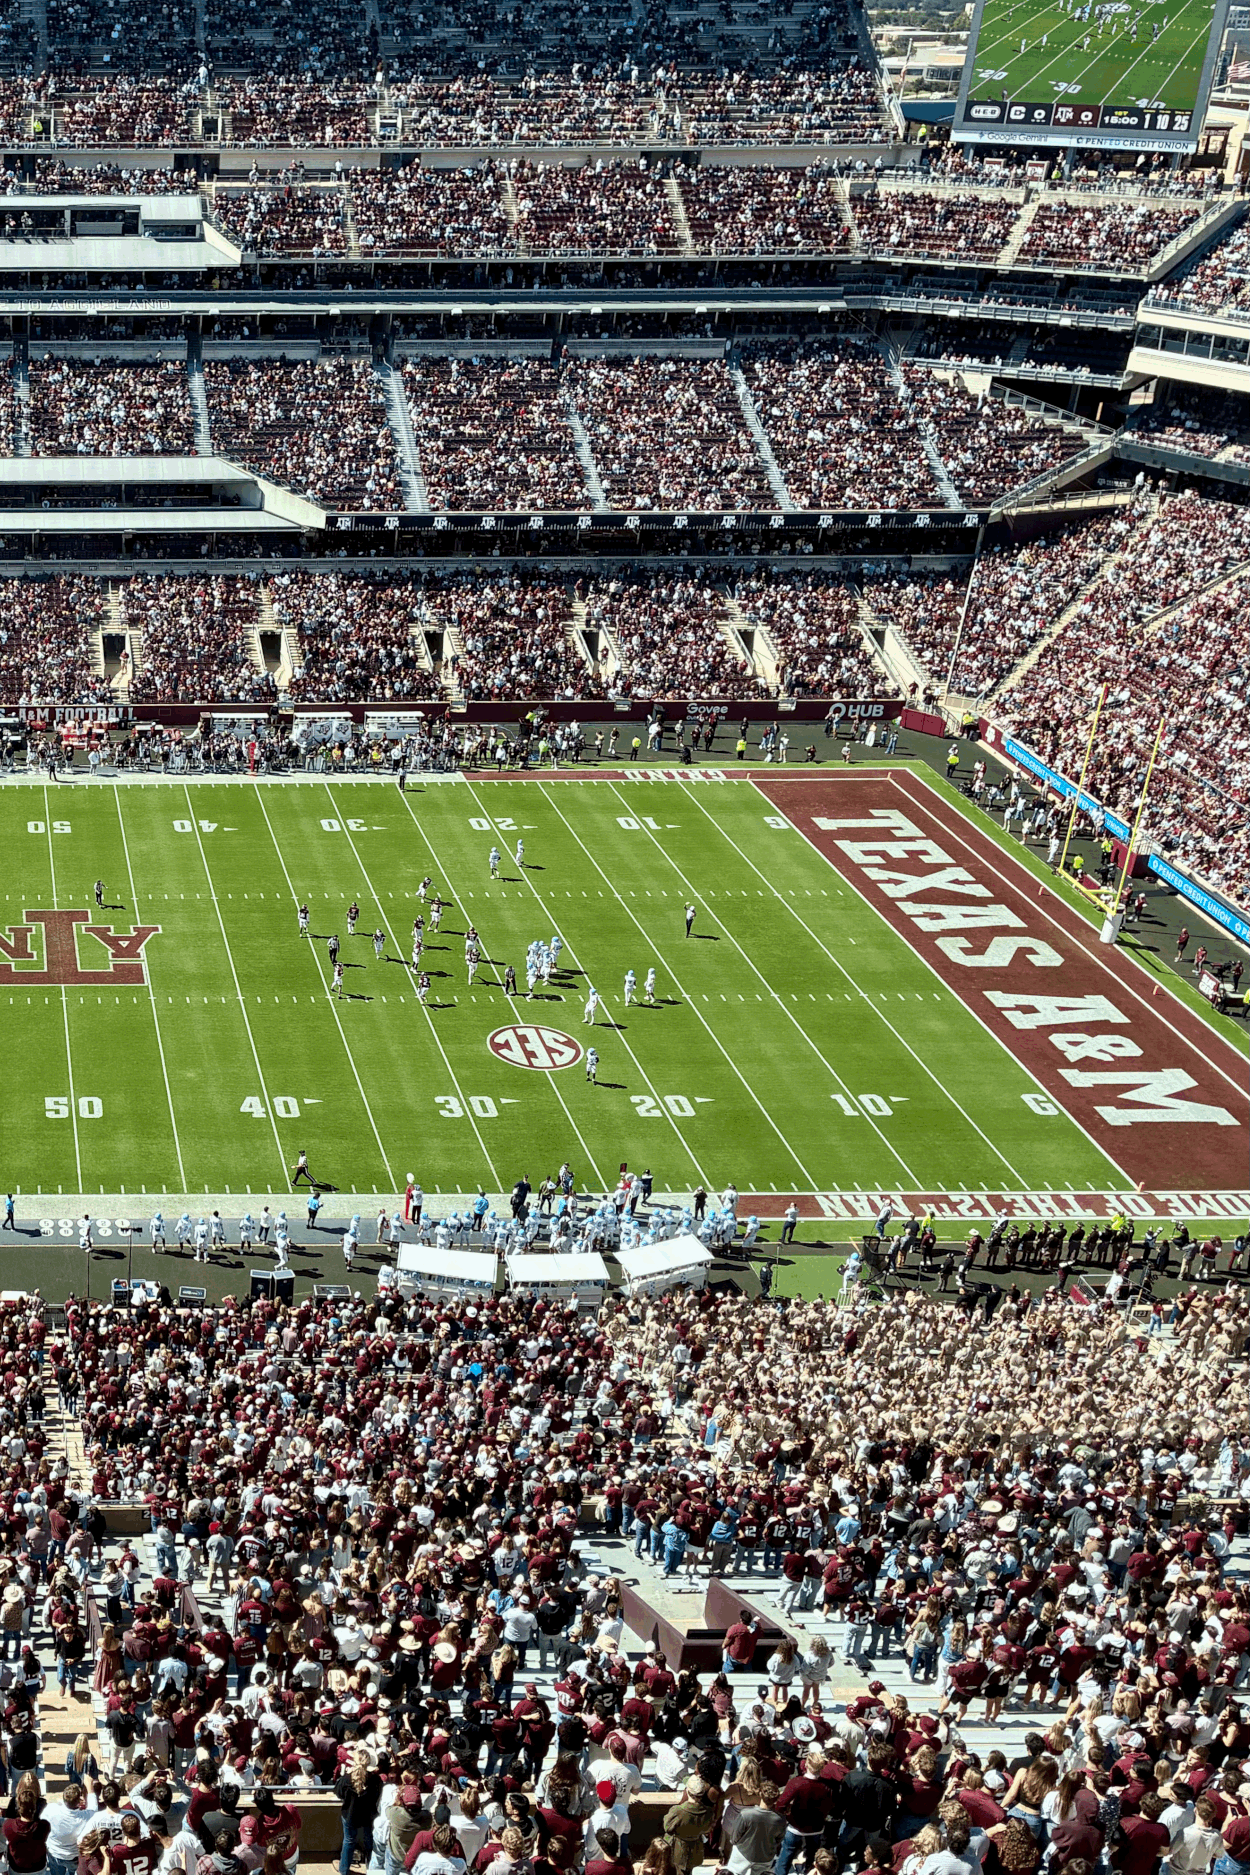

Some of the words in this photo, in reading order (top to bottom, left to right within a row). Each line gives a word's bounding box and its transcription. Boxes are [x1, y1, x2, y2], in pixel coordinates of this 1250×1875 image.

[1103, 116, 1139, 125] 15:00
[1143, 113, 1151, 129] 1
[1156, 114, 1170, 130] 10
[1172, 115, 1190, 131] 25
[987, 132, 1018, 142] Google
[1018, 133, 1049, 142] Gemini
[1085, 137, 1121, 146] PENFED
[1122, 139, 1155, 148] CREDIT
[1157, 141, 1189, 150] UNION
[14, 298, 42, 311] TO
[49, 298, 172, 311] AGGIELAND
[19, 707, 50, 722] A&M
[55, 707, 137, 722] FOOTBALL
[686, 703, 729, 714] Govee
[847, 704, 884, 717] HUB
[27, 820, 73, 835] 50
[172, 819, 219, 833] 40
[320, 818, 367, 832] 30
[467, 817, 519, 832] 20
[615, 816, 666, 831] 10
[763, 817, 792, 830] G
[1158, 863, 1183, 888] PENFED
[1183, 883, 1208, 906] CREDIT
[1207, 900, 1232, 924] UNION
[811, 809, 1066, 967] TEXAS
[982, 990, 1242, 1127] A&M
[493, 1027, 580, 1069] SEC
[44, 1097, 104, 1119] 50
[240, 1096, 301, 1118] 40
[434, 1095, 501, 1117] 30
[630, 1094, 696, 1117] 20
[830, 1093, 894, 1116] 10
[1020, 1093, 1060, 1116] G
[815, 1195, 912, 1218] MAN
[1002, 1194, 1095, 1217] THE
[1105, 1194, 1158, 1216] OF
[1159, 1499, 1174, 1511] 12
[1205, 1504, 1224, 1513] 232
[166, 1507, 178, 1519] 12
[744, 1526, 757, 1538] 12
[773, 1525, 787, 1538] 12
[796, 1525, 811, 1538] 12
[502, 1558, 513, 1569] 12
[249, 1613, 262, 1625] 15
[332, 1614, 346, 1625] 12
[854, 1611, 869, 1624] 12
[319, 1648, 332, 1661] 12
[1109, 1647, 1122, 1656] 12
[1038, 1655, 1055, 1667] 12
[479, 1709, 497, 1724] 12
[123, 1856, 149, 1875] 12
